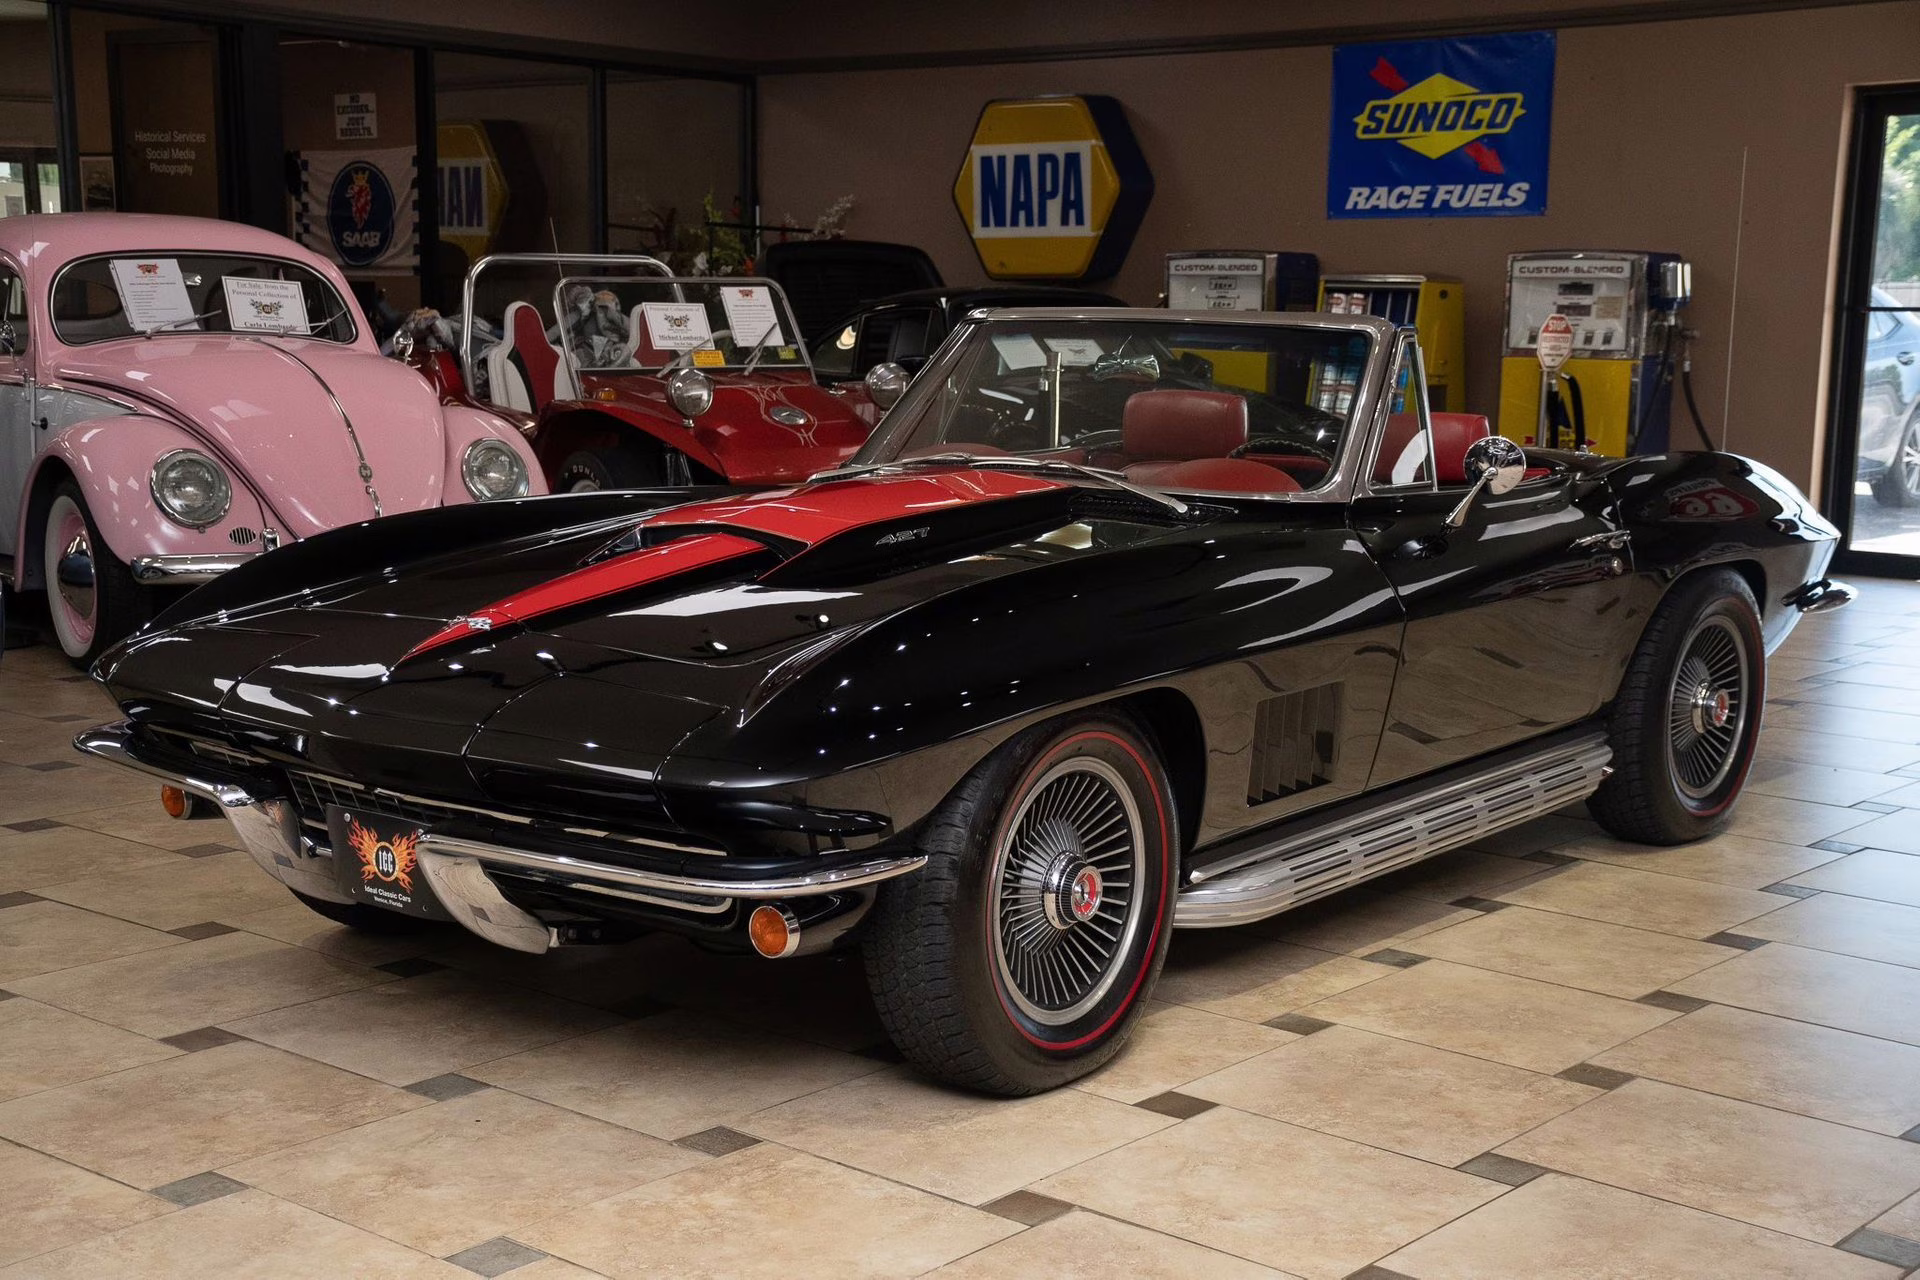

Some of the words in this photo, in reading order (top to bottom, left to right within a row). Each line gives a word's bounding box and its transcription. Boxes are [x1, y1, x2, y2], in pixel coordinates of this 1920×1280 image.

[350, 95, 360, 103] NO
[347, 117, 365, 126] JUST
[1361, 97, 1518, 135] SUNOCO
[134, 130, 171, 142] Historical
[172, 130, 207, 143] Services
[145, 147, 170, 160] Social
[171, 147, 196, 160] Media
[149, 162, 193, 176] Photography
[980, 152, 1085, 228] NAPA
[1345, 185, 1431, 210] RACE
[1431, 182, 1531, 209] FUELS
[342, 231, 381, 248] SAAB
[1174, 264, 1258, 272] CUSTOM-BLENDED
[1518, 266, 1624, 274] CUSTOM-BLENDED
[231, 289, 257, 297] Personal
[1548, 319, 1567, 331] STOP
[874, 526, 930, 546] 427
[364, 885, 378, 894] Ideal
[378, 888, 398, 899] Classic
[398, 893, 412, 903] Cars
[389, 899, 404, 908] Florida
